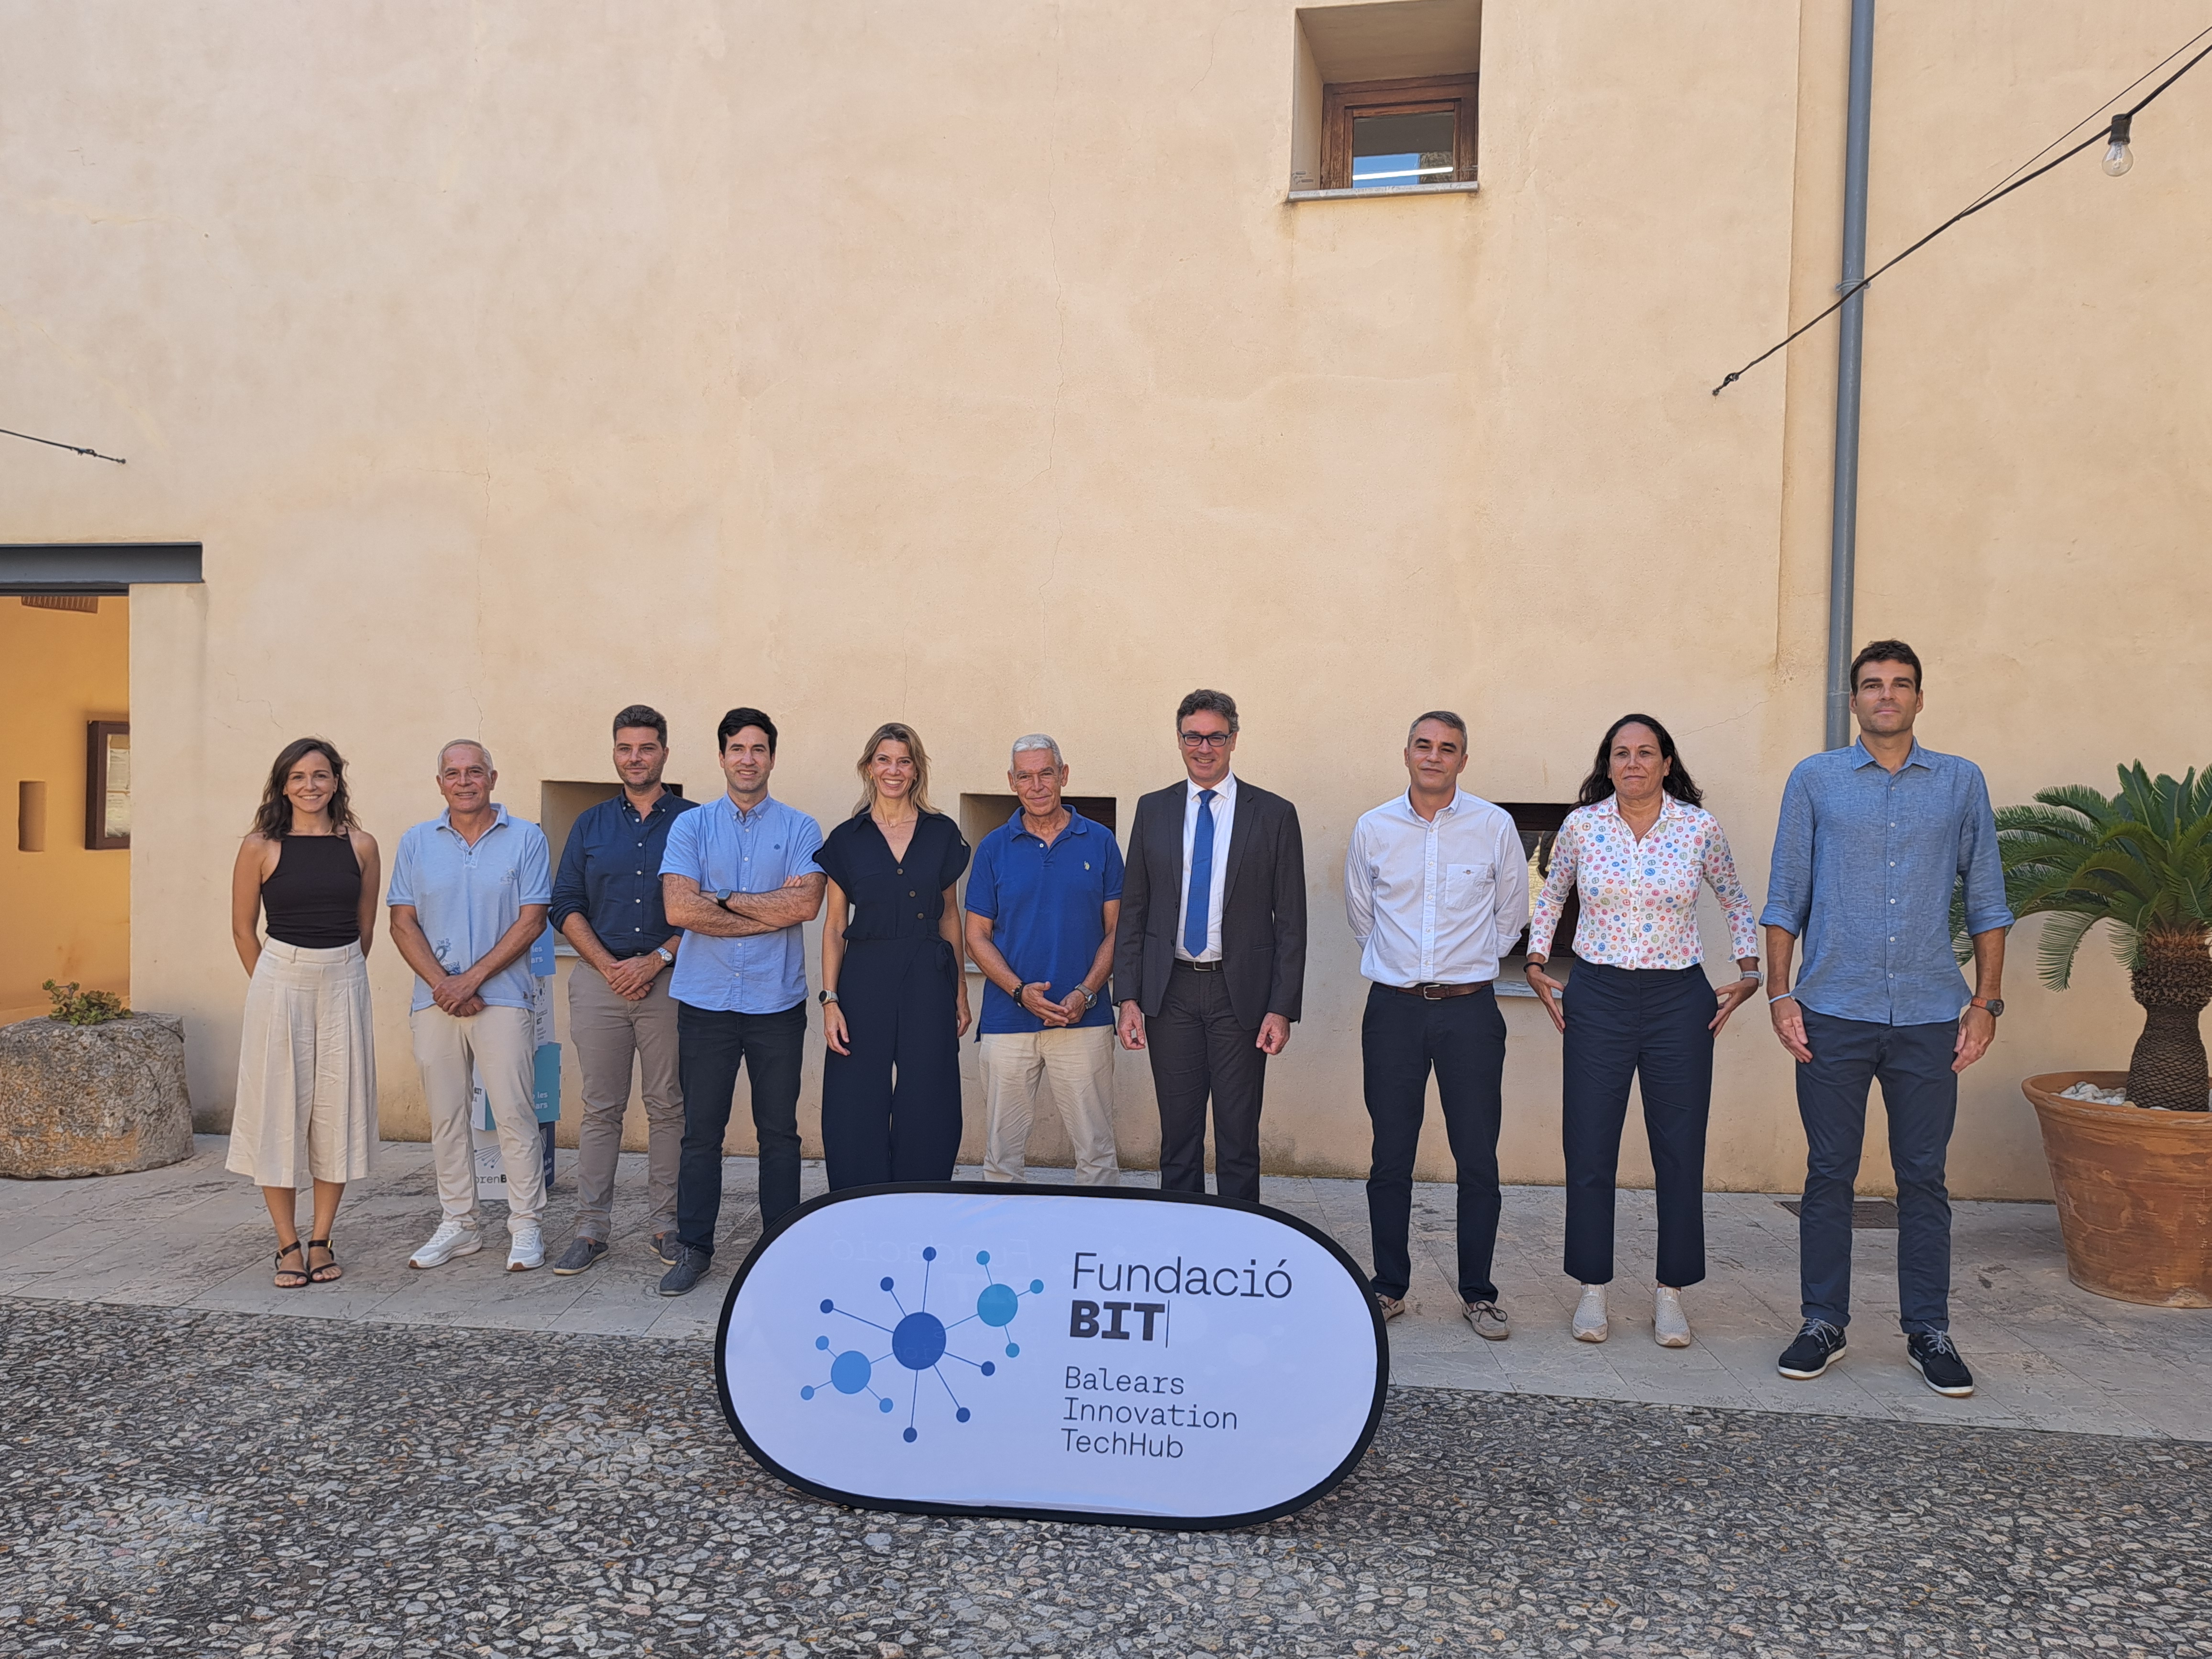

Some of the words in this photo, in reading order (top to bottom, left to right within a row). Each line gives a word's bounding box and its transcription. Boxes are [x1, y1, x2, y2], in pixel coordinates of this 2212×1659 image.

[1073, 1252, 1292, 1298] Fundació
[1070, 1299, 1165, 1341] BIT
[1065, 1366, 1184, 1394] Balears
[1063, 1396, 1238, 1430] Innovation
[1061, 1428, 1183, 1458] TechHub
